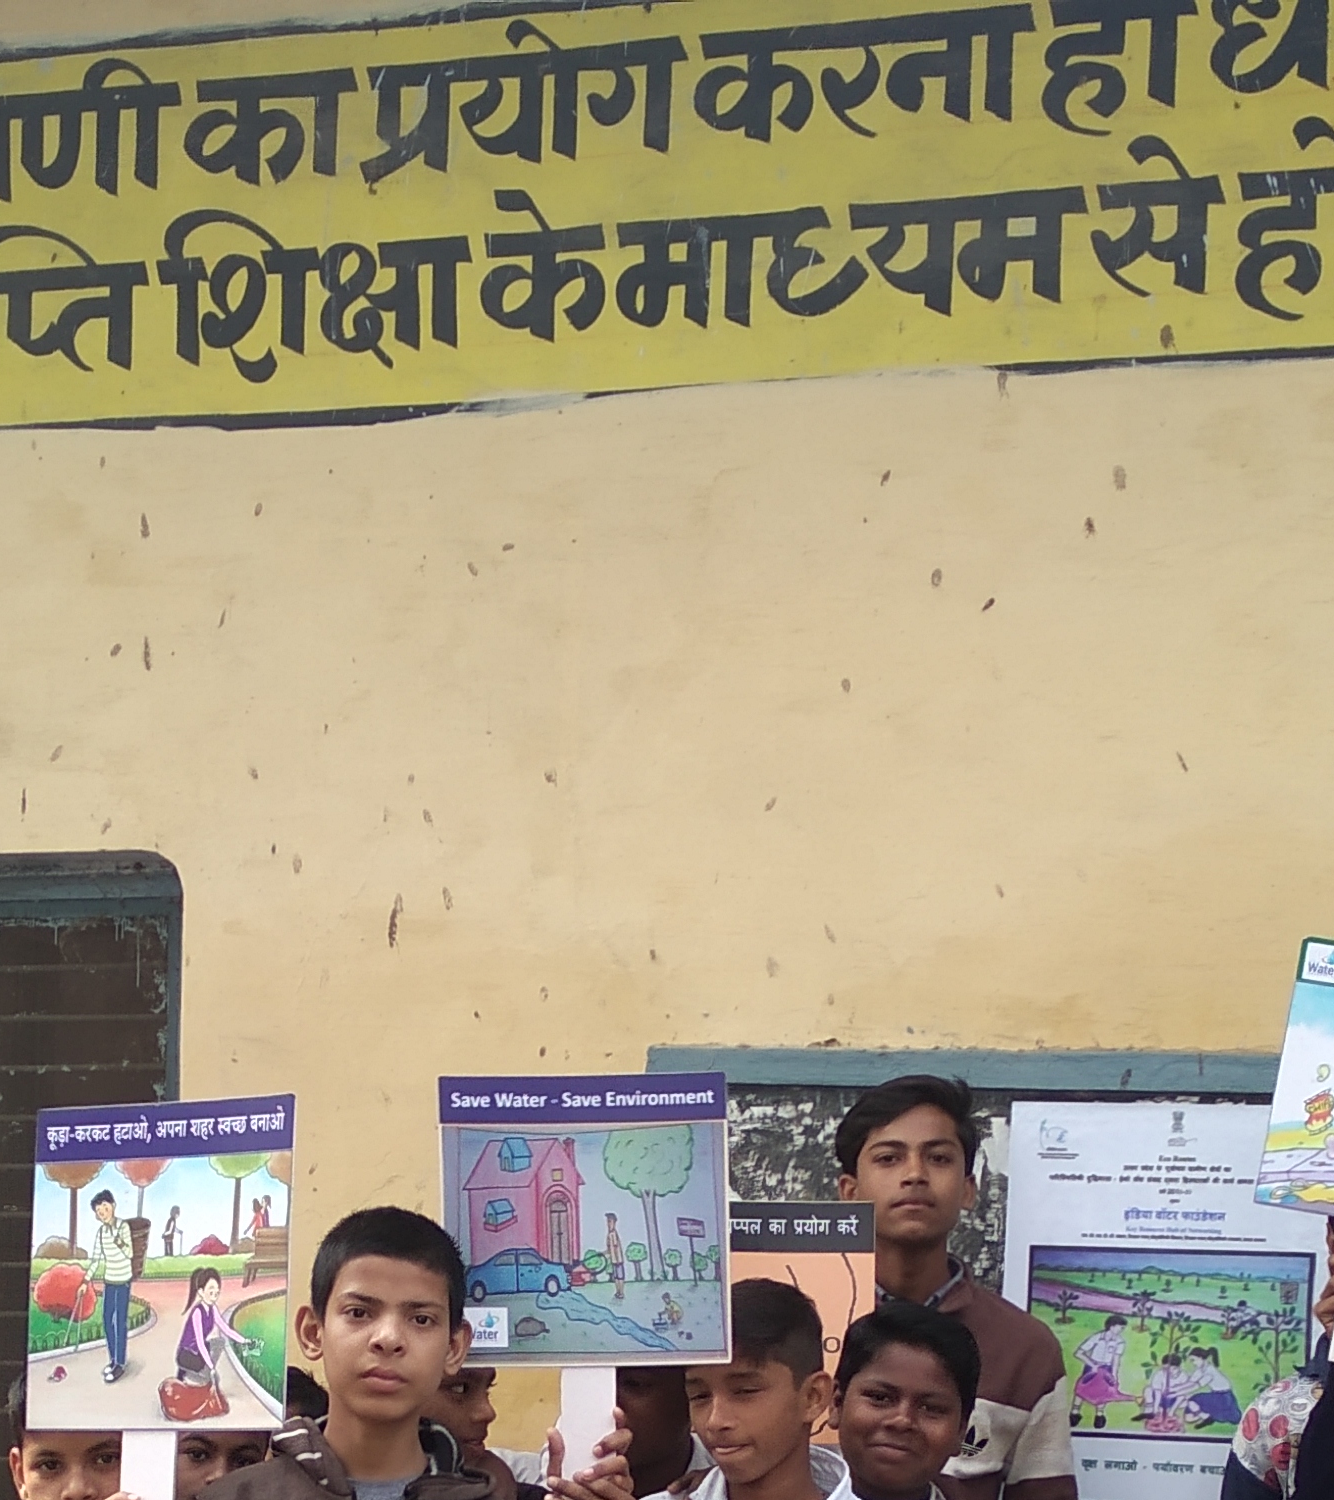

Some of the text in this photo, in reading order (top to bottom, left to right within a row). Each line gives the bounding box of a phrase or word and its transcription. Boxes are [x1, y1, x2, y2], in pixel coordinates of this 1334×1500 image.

[183, 67, 357, 184] का
[359, 19, 688, 183] प्रयोग
[694, 3, 1037, 143] करना
[158, 209, 471, 385] शिक्षा
[479, 189, 606, 343] के
[616, 186, 1087, 328] माध्यम
[1091, 134, 1224, 297] से
[450, 1092, 491, 1108] Save
[494, 1092, 548, 1108] Water
[561, 1091, 601, 1108] Save
[605, 1089, 715, 1107] Environment
[155, 1120, 187, 1138] अपना
[190, 1118, 215, 1140] शहर
[217, 1115, 247, 1135] स्वच्छ
[250, 1105, 285, 1131] बनाओ
[769, 1218, 787, 1235] का
[793, 1214, 831, 1236] प्रयोग
[837, 1215, 859, 1236] करें
